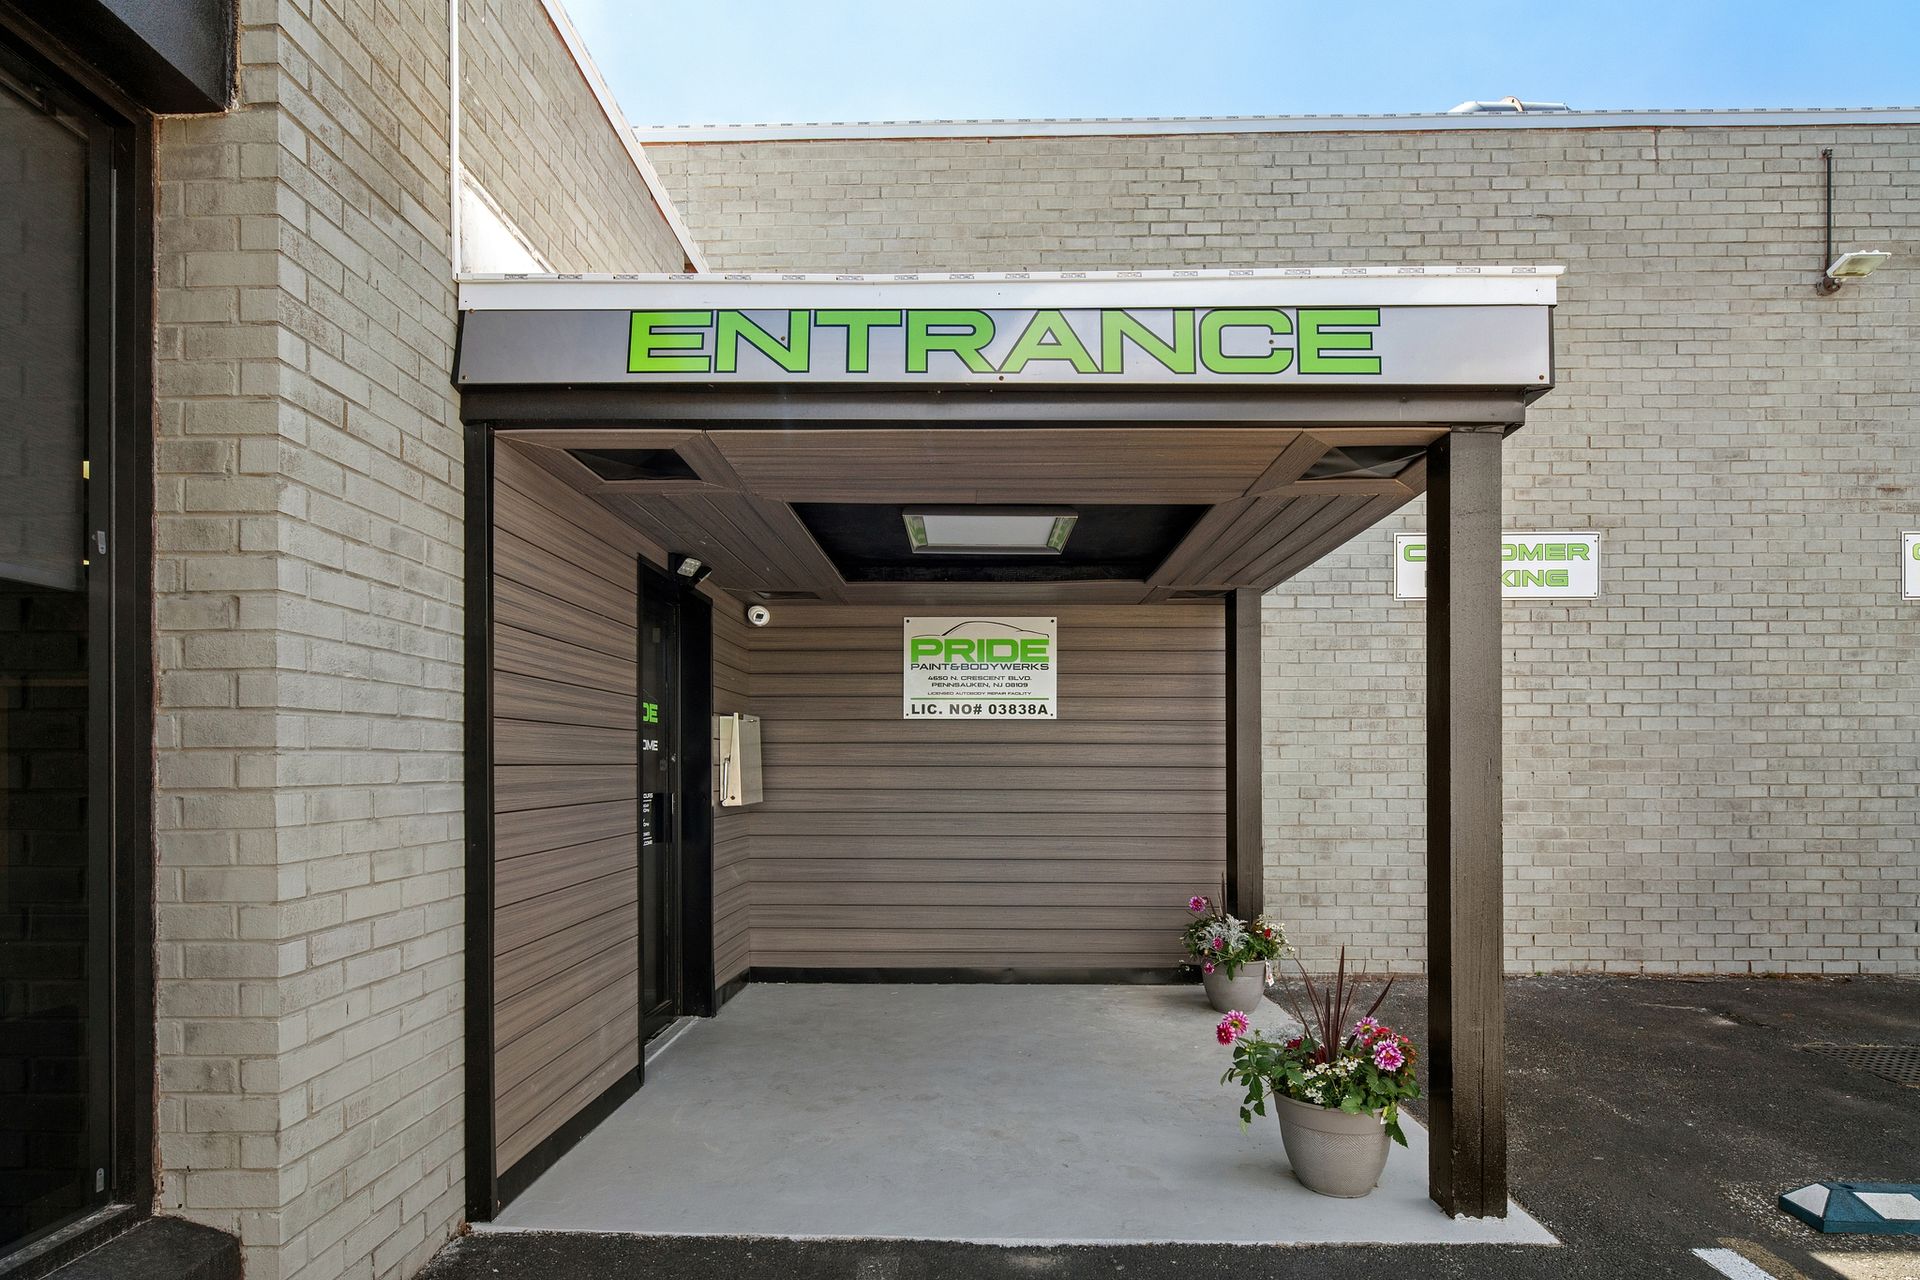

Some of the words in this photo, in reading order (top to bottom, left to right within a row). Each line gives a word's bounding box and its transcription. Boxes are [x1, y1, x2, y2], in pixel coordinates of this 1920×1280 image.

[627, 308, 1382, 375] ENTRANCE
[1403, 543, 1590, 562] COMER
[910, 639, 1050, 663] PRIDE
[910, 663, 1050, 671] PAINT&BODYWERKS
[911, 704, 943, 715] LIC.
[949, 704, 983, 715] NO#
[988, 704, 1048, 715] 03838A
